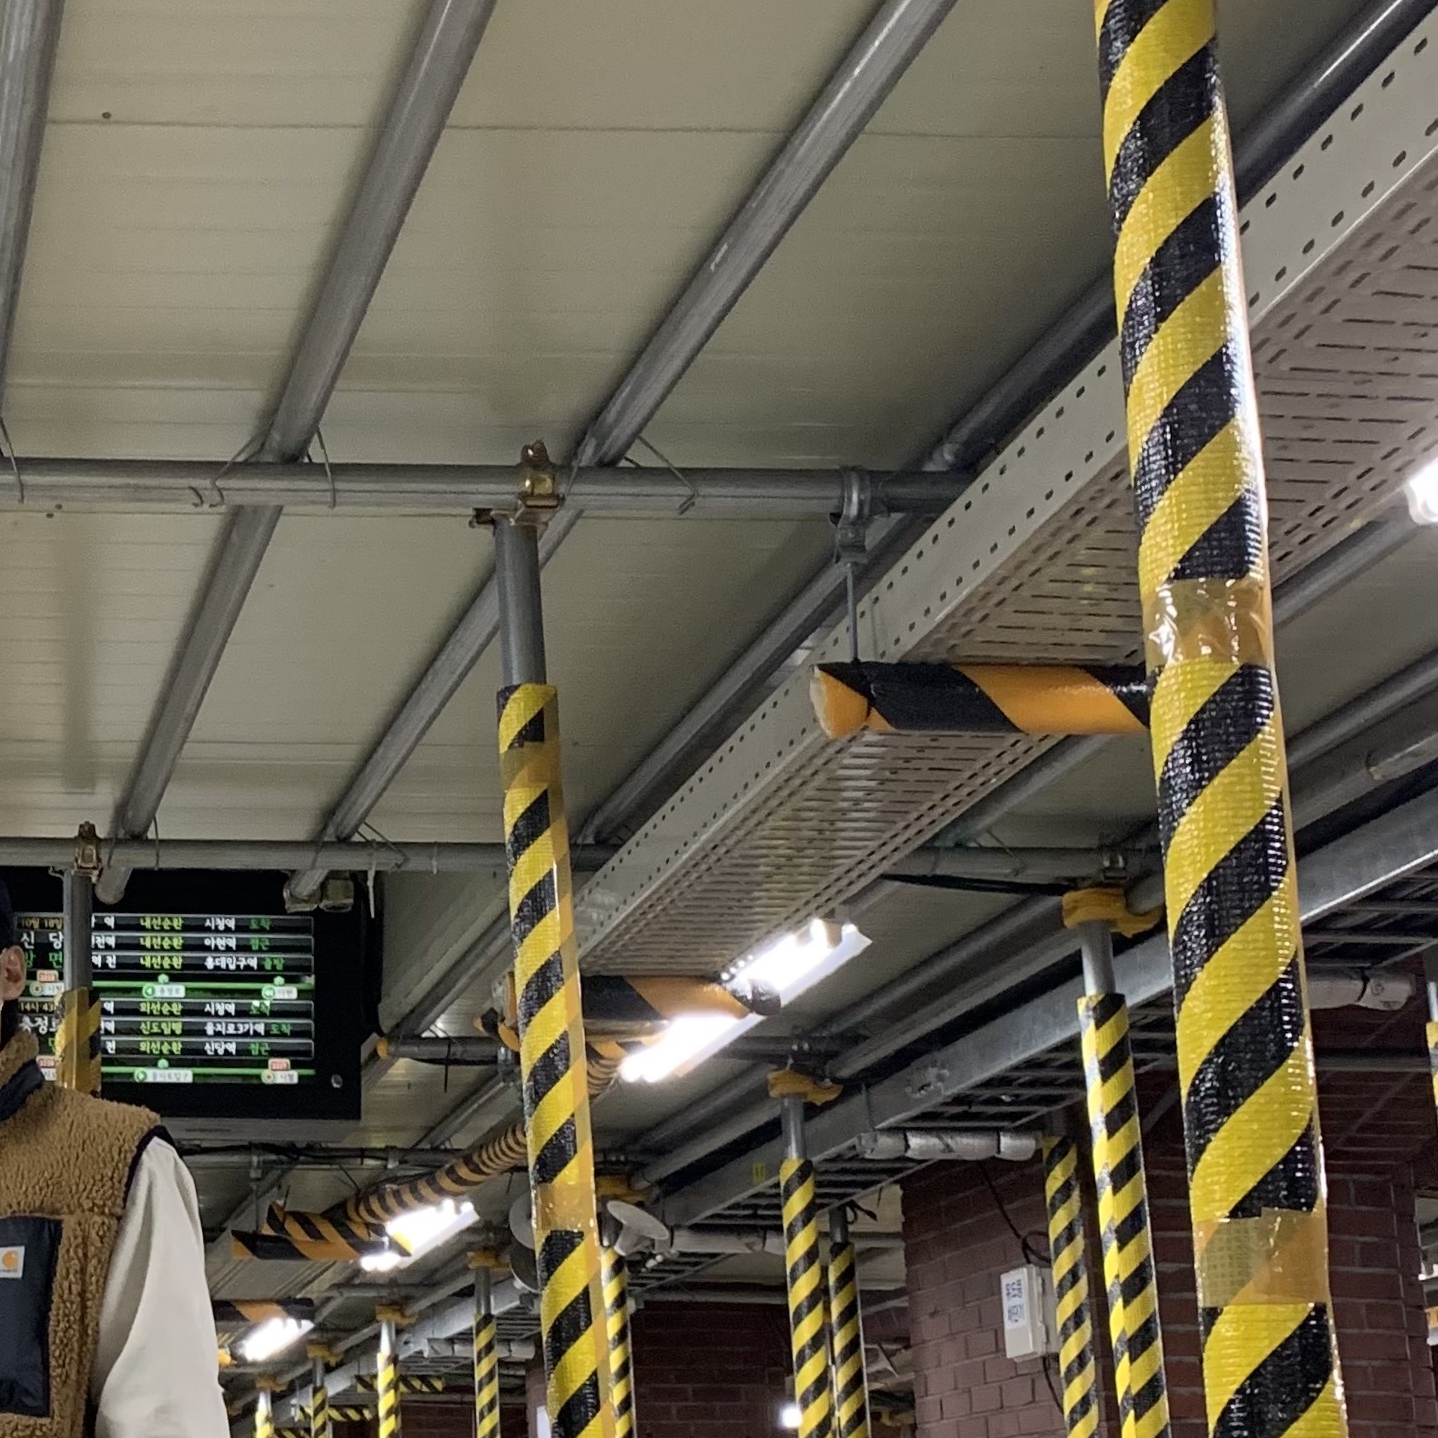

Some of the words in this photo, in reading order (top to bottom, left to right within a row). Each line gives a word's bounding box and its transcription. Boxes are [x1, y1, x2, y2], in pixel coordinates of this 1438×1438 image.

[140, 916, 184, 930] 내선순환
[204, 917, 236, 931] 시청역
[140, 936, 184, 950] 내선순환
[204, 936, 237, 950] 아현역
[140, 955, 183, 969] 내선순환
[204, 956, 258, 970] 홍대입구역
[204, 1002, 236, 1016] 시청역
[204, 1021, 265, 1036] 을지로3가역
[204, 1041, 237, 1056] 신당역
